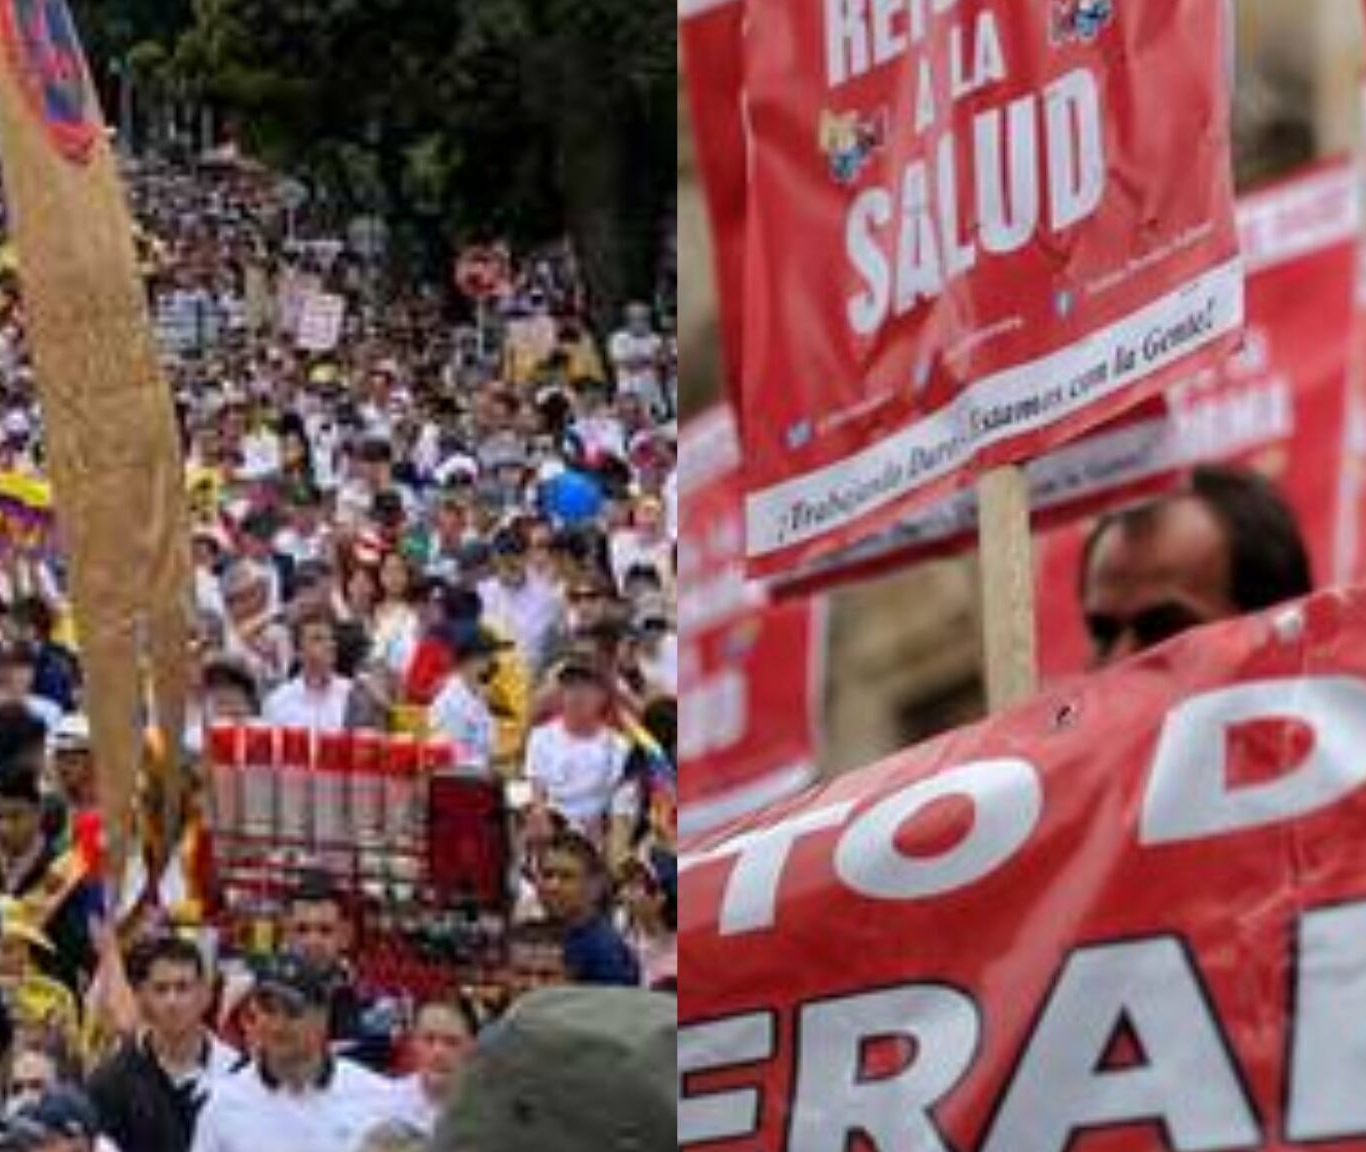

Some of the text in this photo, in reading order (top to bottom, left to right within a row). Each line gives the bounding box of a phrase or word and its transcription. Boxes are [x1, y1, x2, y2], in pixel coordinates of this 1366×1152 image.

[914, 7, 1008, 135] A LA
[845, 66, 1108, 337] SALUD
